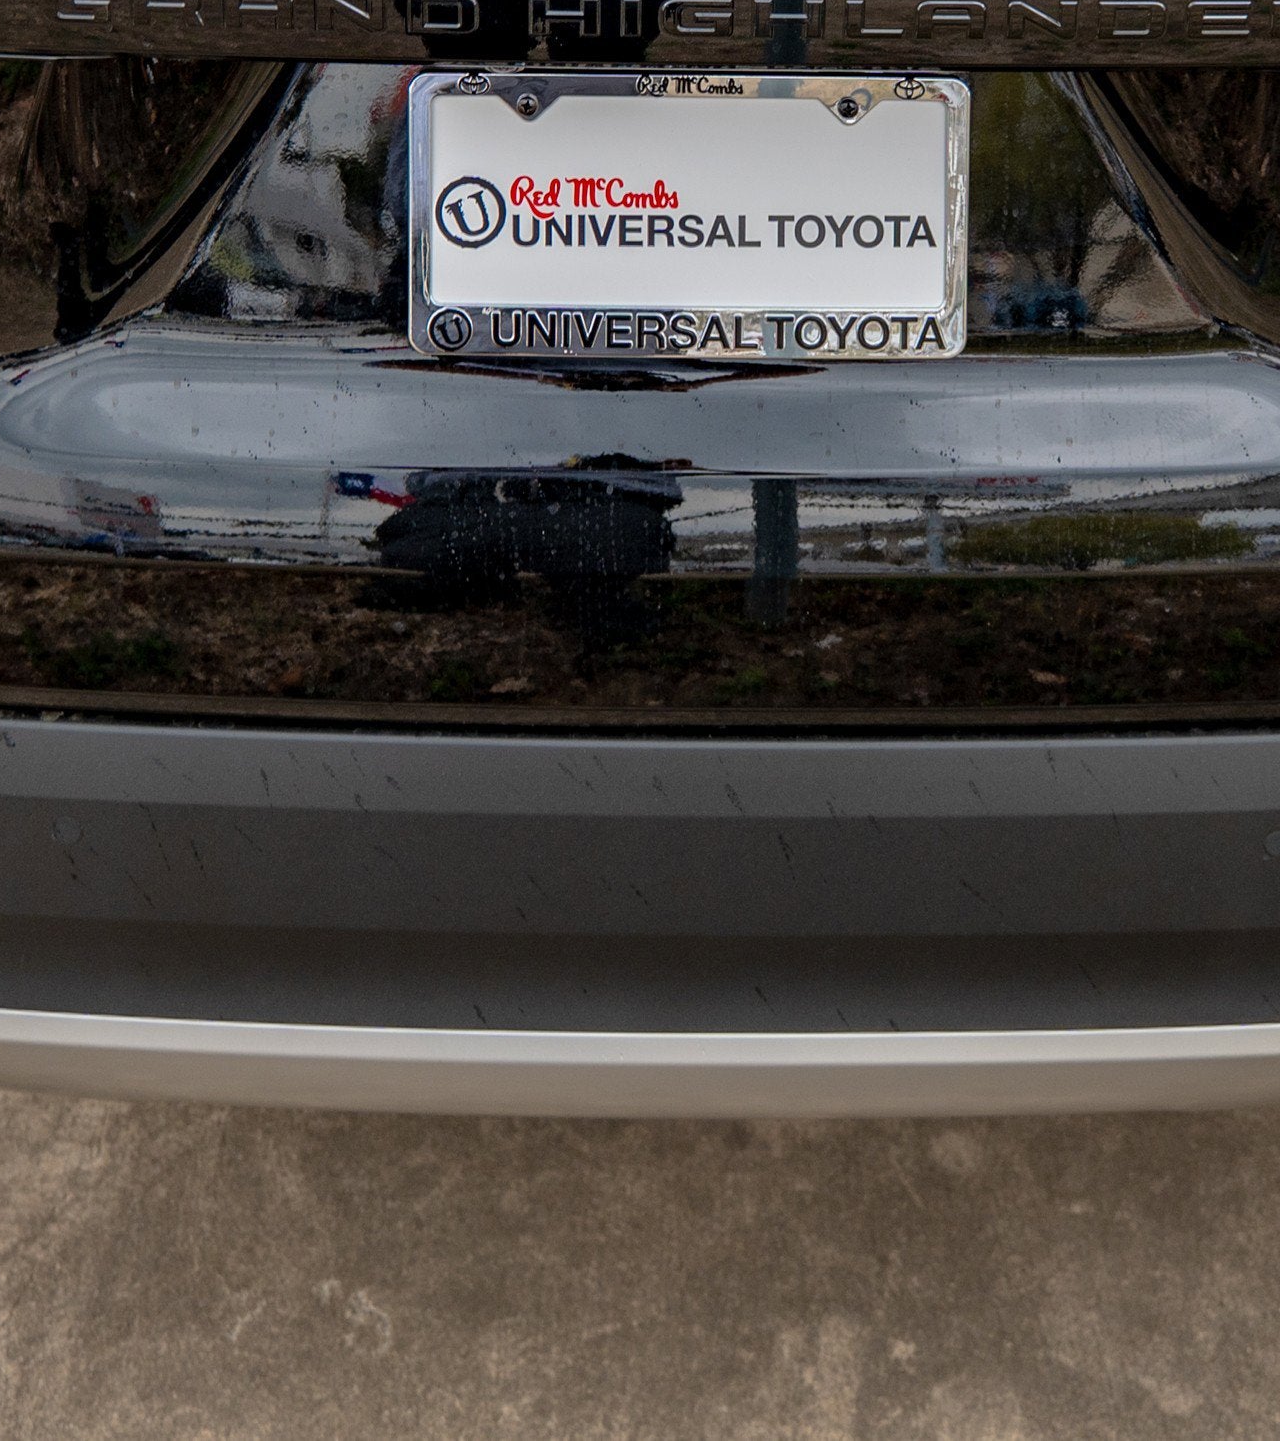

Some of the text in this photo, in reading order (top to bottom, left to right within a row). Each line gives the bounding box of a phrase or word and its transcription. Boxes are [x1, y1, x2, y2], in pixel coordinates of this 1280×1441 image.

[637, 74, 744, 97] Red McCombs
[510, 175, 680, 220] Red McCombs
[512, 214, 938, 248] UNIVERSAL TOYOTA
[490, 310, 949, 351] UNIVERSAL TOYOTA
